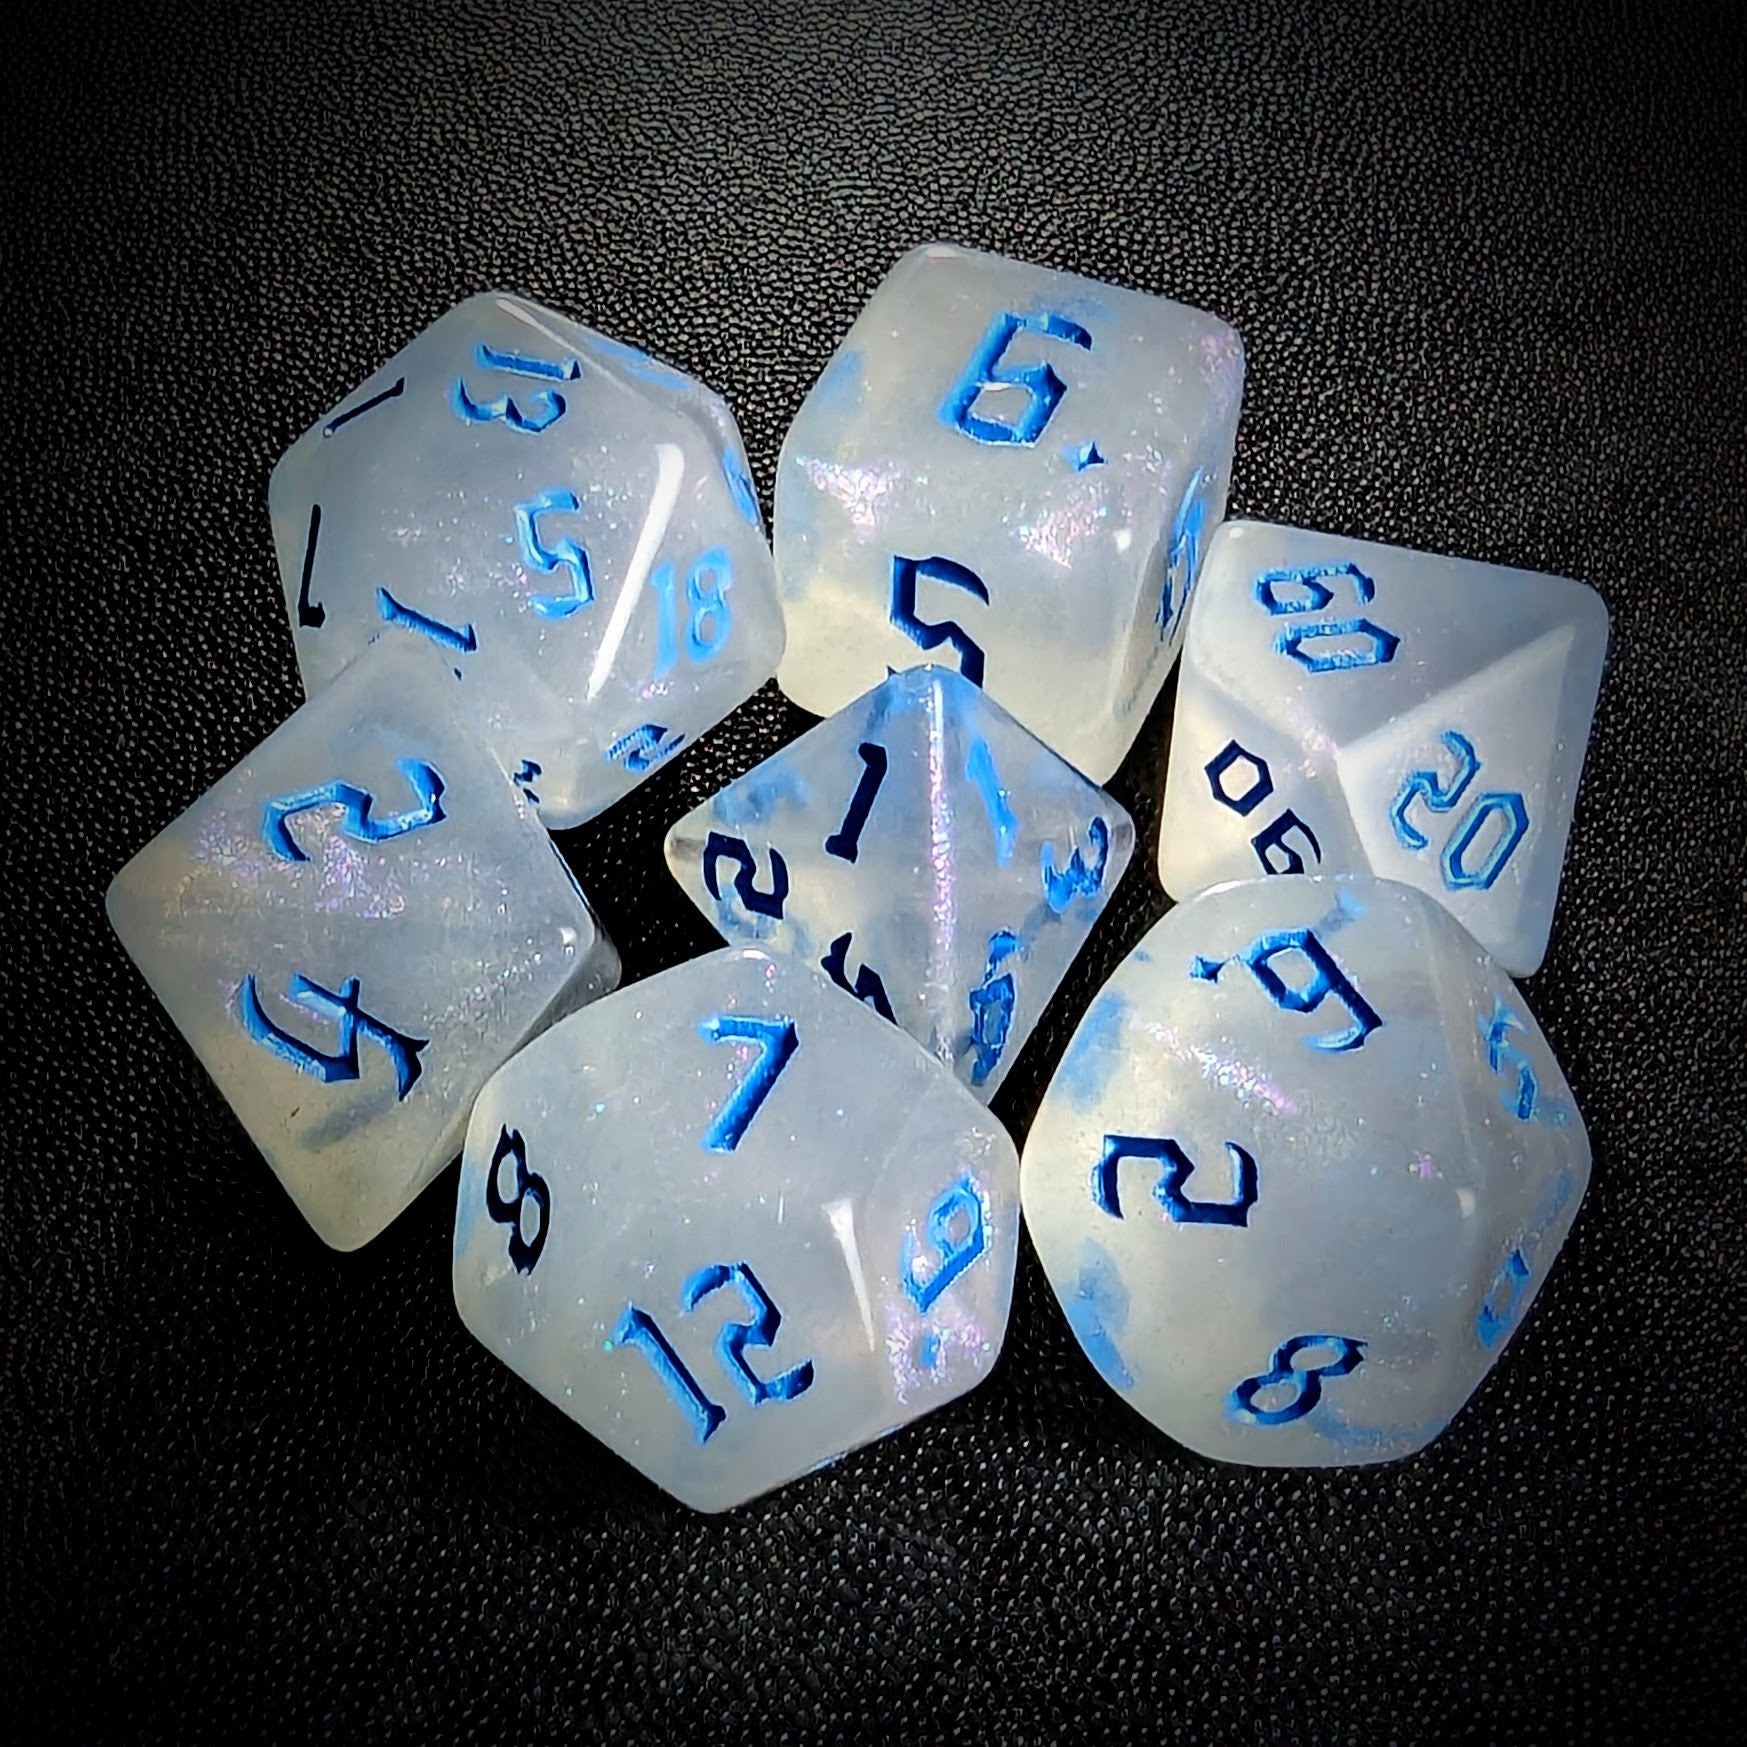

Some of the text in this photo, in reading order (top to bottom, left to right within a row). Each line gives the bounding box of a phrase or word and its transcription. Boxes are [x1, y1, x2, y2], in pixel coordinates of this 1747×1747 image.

[453, 342, 582, 434] 13
[512, 489, 598, 620] 5
[651, 547, 733, 680] 18
[888, 555, 990, 689] 5
[260, 757, 448, 862] 2
[825, 742, 888, 863] 1
[1388, 730, 1530, 891] 20
[702, 831, 790, 920] 2
[235, 972, 430, 1101] 4
[697, 1013, 799, 1152] 7
[486, 1122, 552, 1276] 8
[1092, 1133, 1258, 1228] 2
[610, 1262, 815, 1443] 12
[1225, 1334, 1369, 1427] 8
